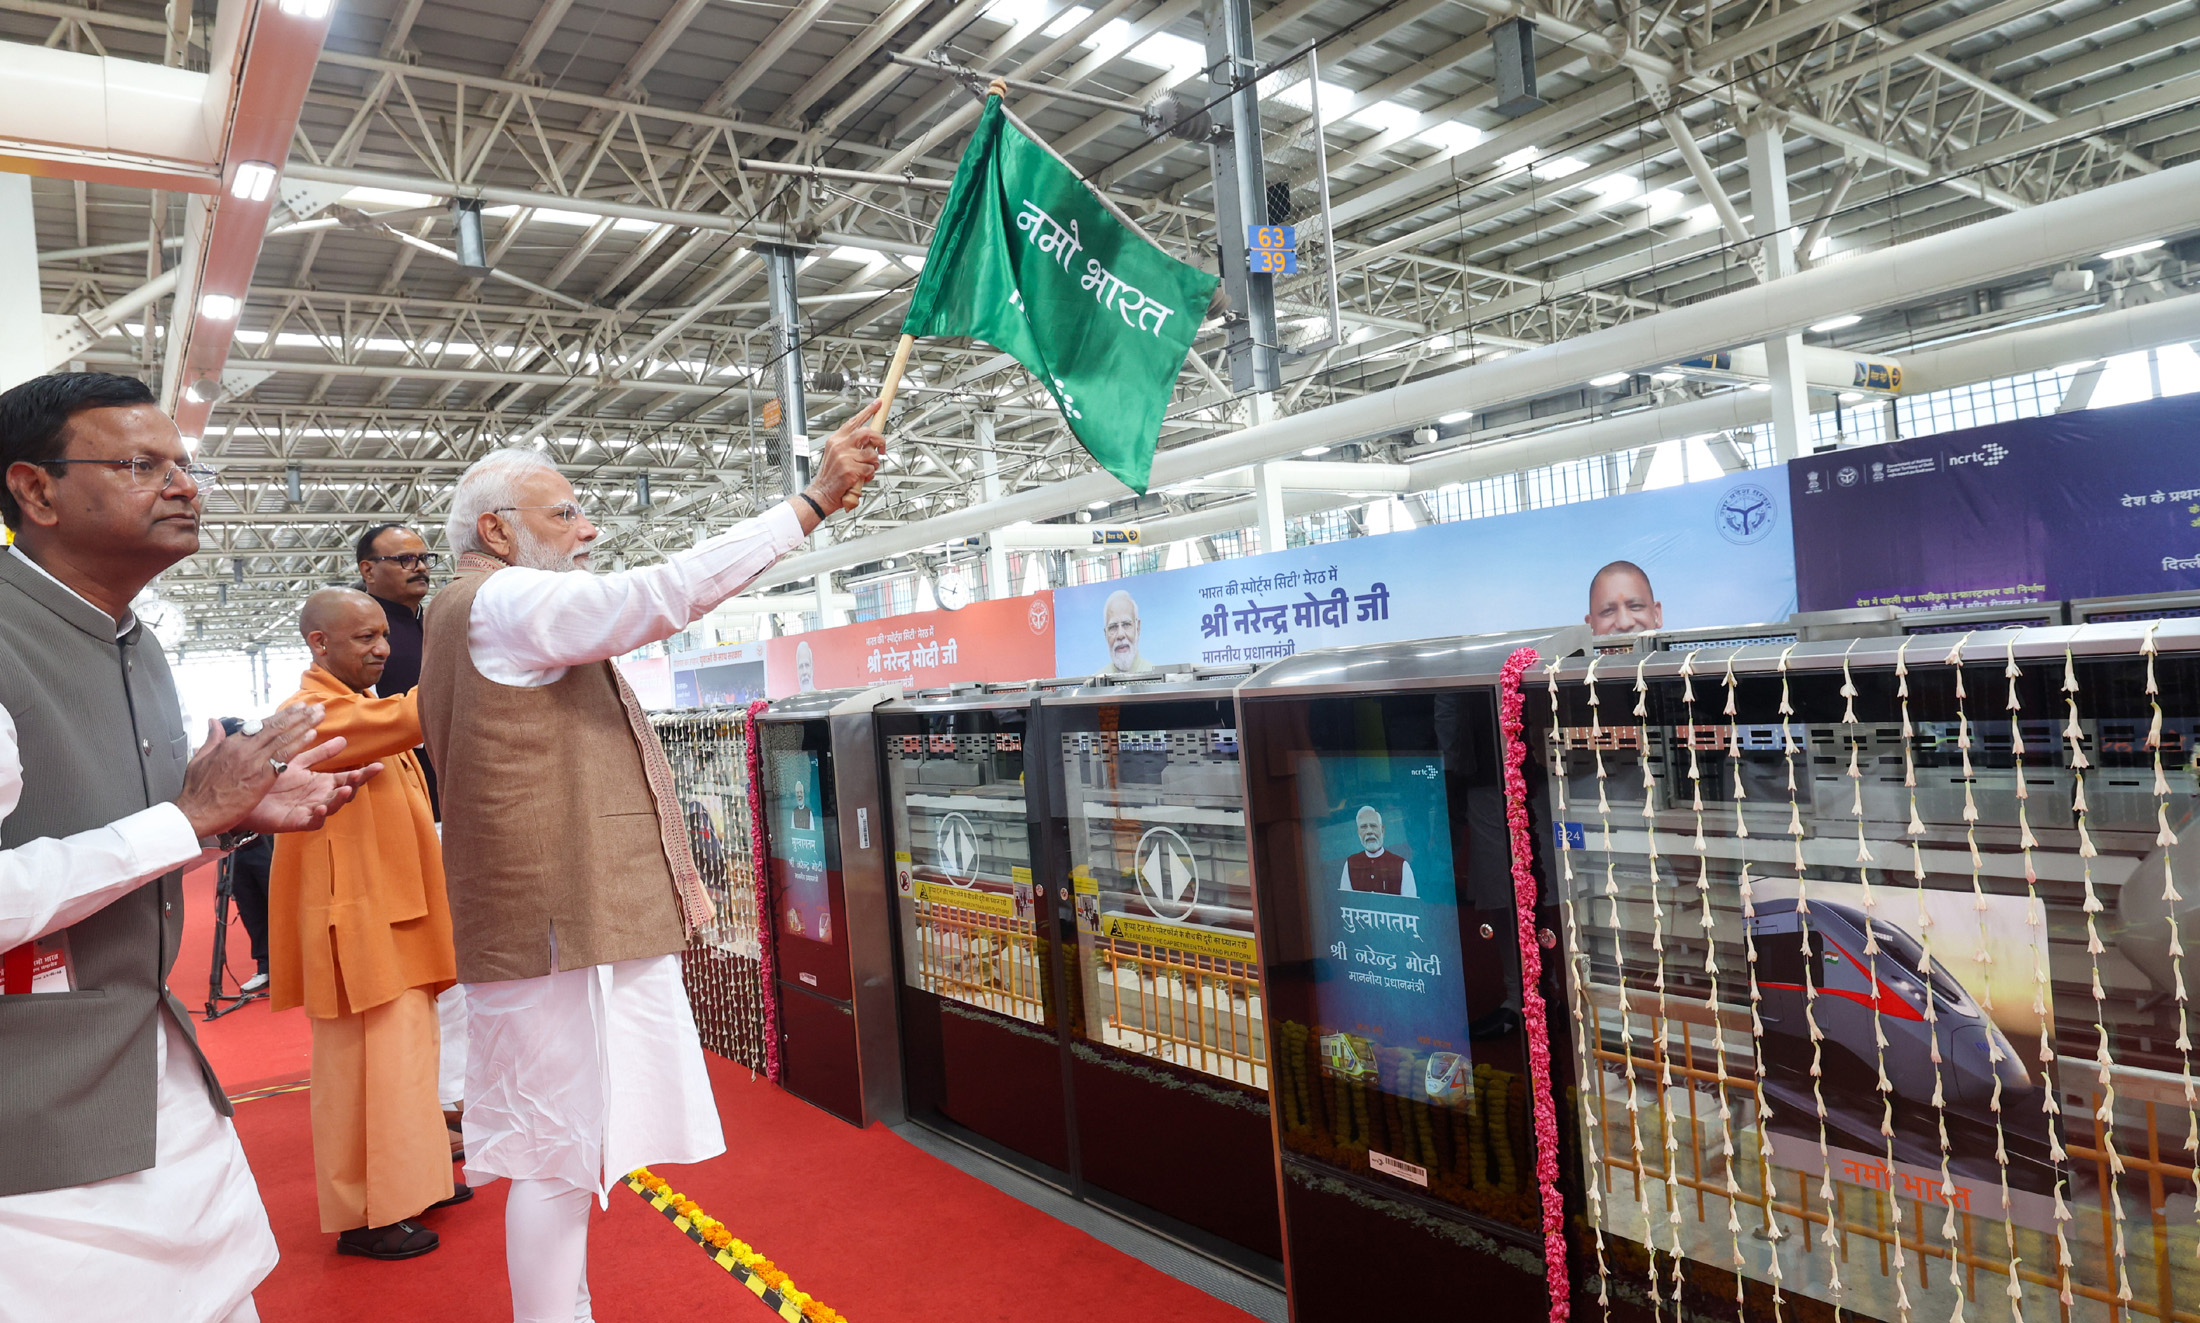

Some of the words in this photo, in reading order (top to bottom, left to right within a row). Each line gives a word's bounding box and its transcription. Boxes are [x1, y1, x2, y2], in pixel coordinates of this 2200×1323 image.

[1258, 227, 1285, 247] 63
[1016, 199, 1083, 273] नमो
[1080, 258, 1174, 338] भारत
[1261, 252, 1286, 272] 39
[1950, 452, 1985, 466] ncrtc
[2120, 493, 2147, 507] देश
[2150, 490, 2166, 504] के
[1225, 580, 1239, 596] की
[1240, 575, 1272, 597] स्पोर्ट्स
[1303, 568, 1326, 585] मेरठ
[1328, 565, 1338, 582] में
[1857, 598, 1870, 606] देश
[1880, 594, 1901, 604] पहली
[1918, 592, 1949, 603] एकीकृत
[2017, 583, 2046, 593] निर्माण
[1201, 603, 1228, 639] श्री
[1232, 600, 1288, 635] नरेन्द्र
[1292, 587, 1350, 628] मोदी
[1354, 582, 1390, 621] जी
[877, 633, 884, 644] की
[917, 627, 929, 638] मेरठ
[867, 648, 881, 673] श्री
[882, 647, 910, 672] नरेन्द्र
[912, 640, 939, 668] मोदी
[941, 638, 957, 664] जी
[1202, 645, 1240, 664] माननीय
[1243, 639, 1295, 661] प्रधानमंत्री
[1340, 907, 1424, 942] सुस्वागतम्
[1224, 951, 1251, 960] PLATFORM
[1330, 941, 1348, 960] श्री
[1354, 945, 1397, 970] नरेन्द्र
[1405, 951, 1442, 976] मोदी
[1348, 971, 1382, 986] माननीय
[1384, 977, 1425, 994] प्रधानमंत्री
[1842, 1159, 1891, 1191] नमो
